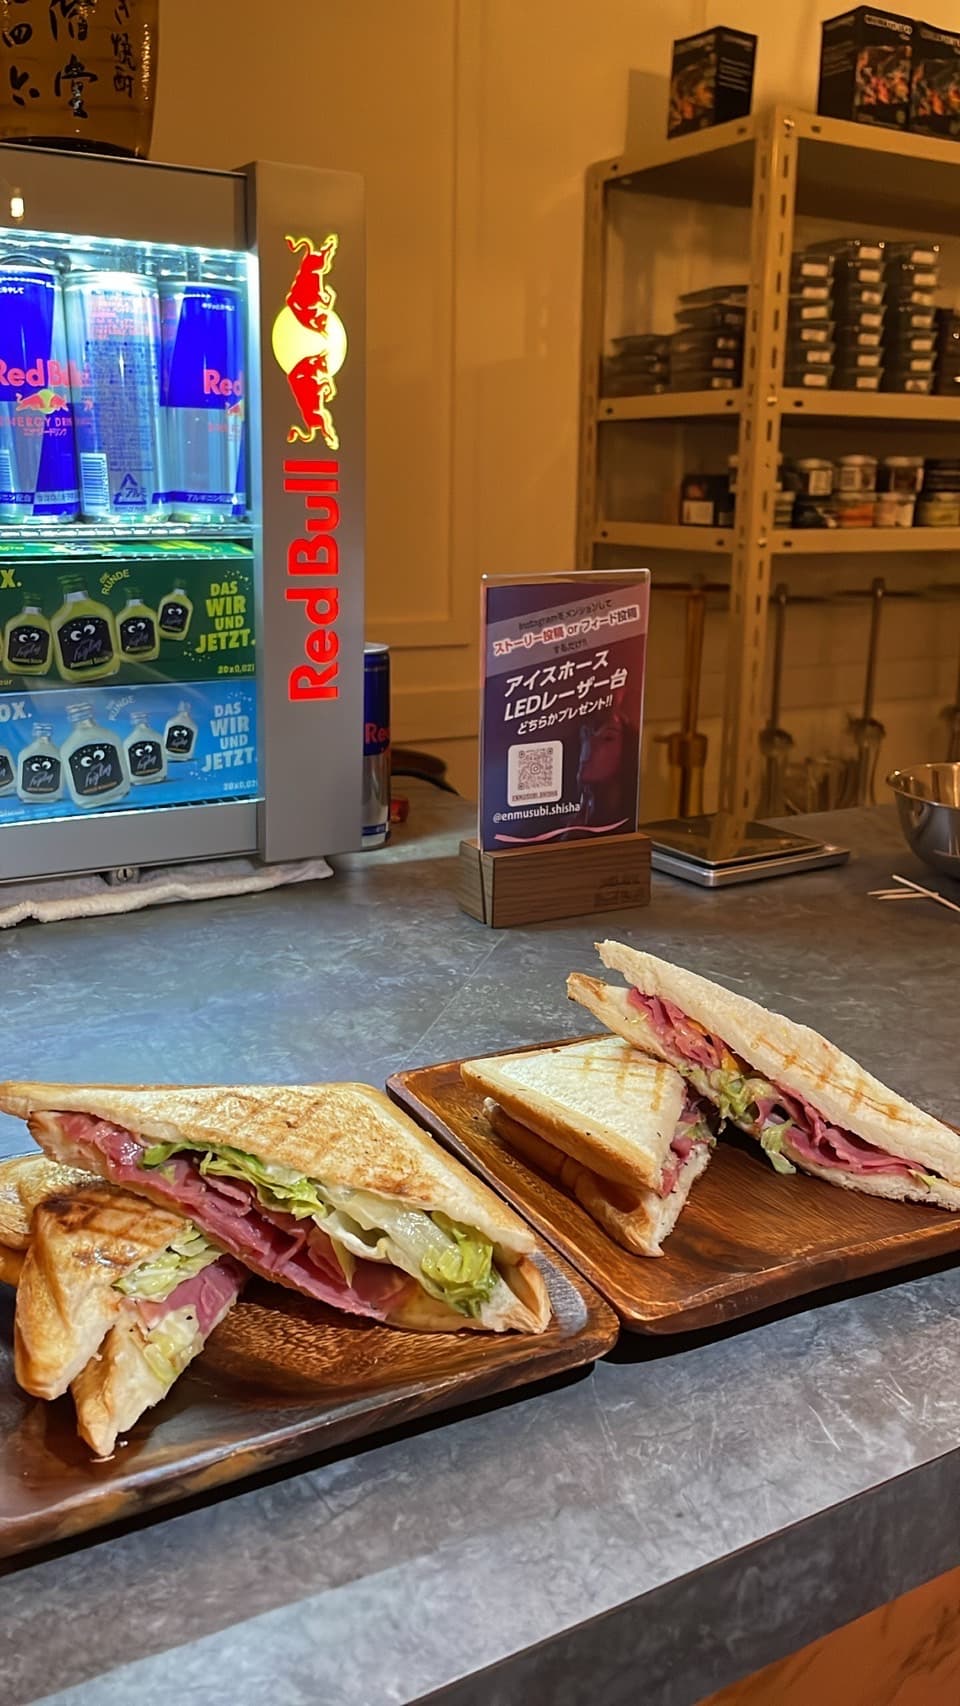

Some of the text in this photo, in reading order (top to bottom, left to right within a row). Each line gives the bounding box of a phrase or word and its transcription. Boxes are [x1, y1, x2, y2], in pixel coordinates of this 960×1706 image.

[0, 358, 45, 387] Red
[102, 569, 130, 595] RUNDE
[210, 581, 238, 597] DAS
[284, 459, 339, 703] Red Bull
[206, 596, 246, 617] WIR
[214, 616, 244, 631] UND
[494, 605, 640, 656] ストーリー投稿 or フィード投稿
[195, 629, 256, 654] JETZT.
[504, 650, 609, 698] アイスホース
[503, 668, 628, 722] LEDレーザー台
[214, 702, 242, 718] DAS
[210, 716, 249, 737] WIR
[220, 734, 248, 750] UND
[493, 802, 581, 824] @enmusubi.shisha
